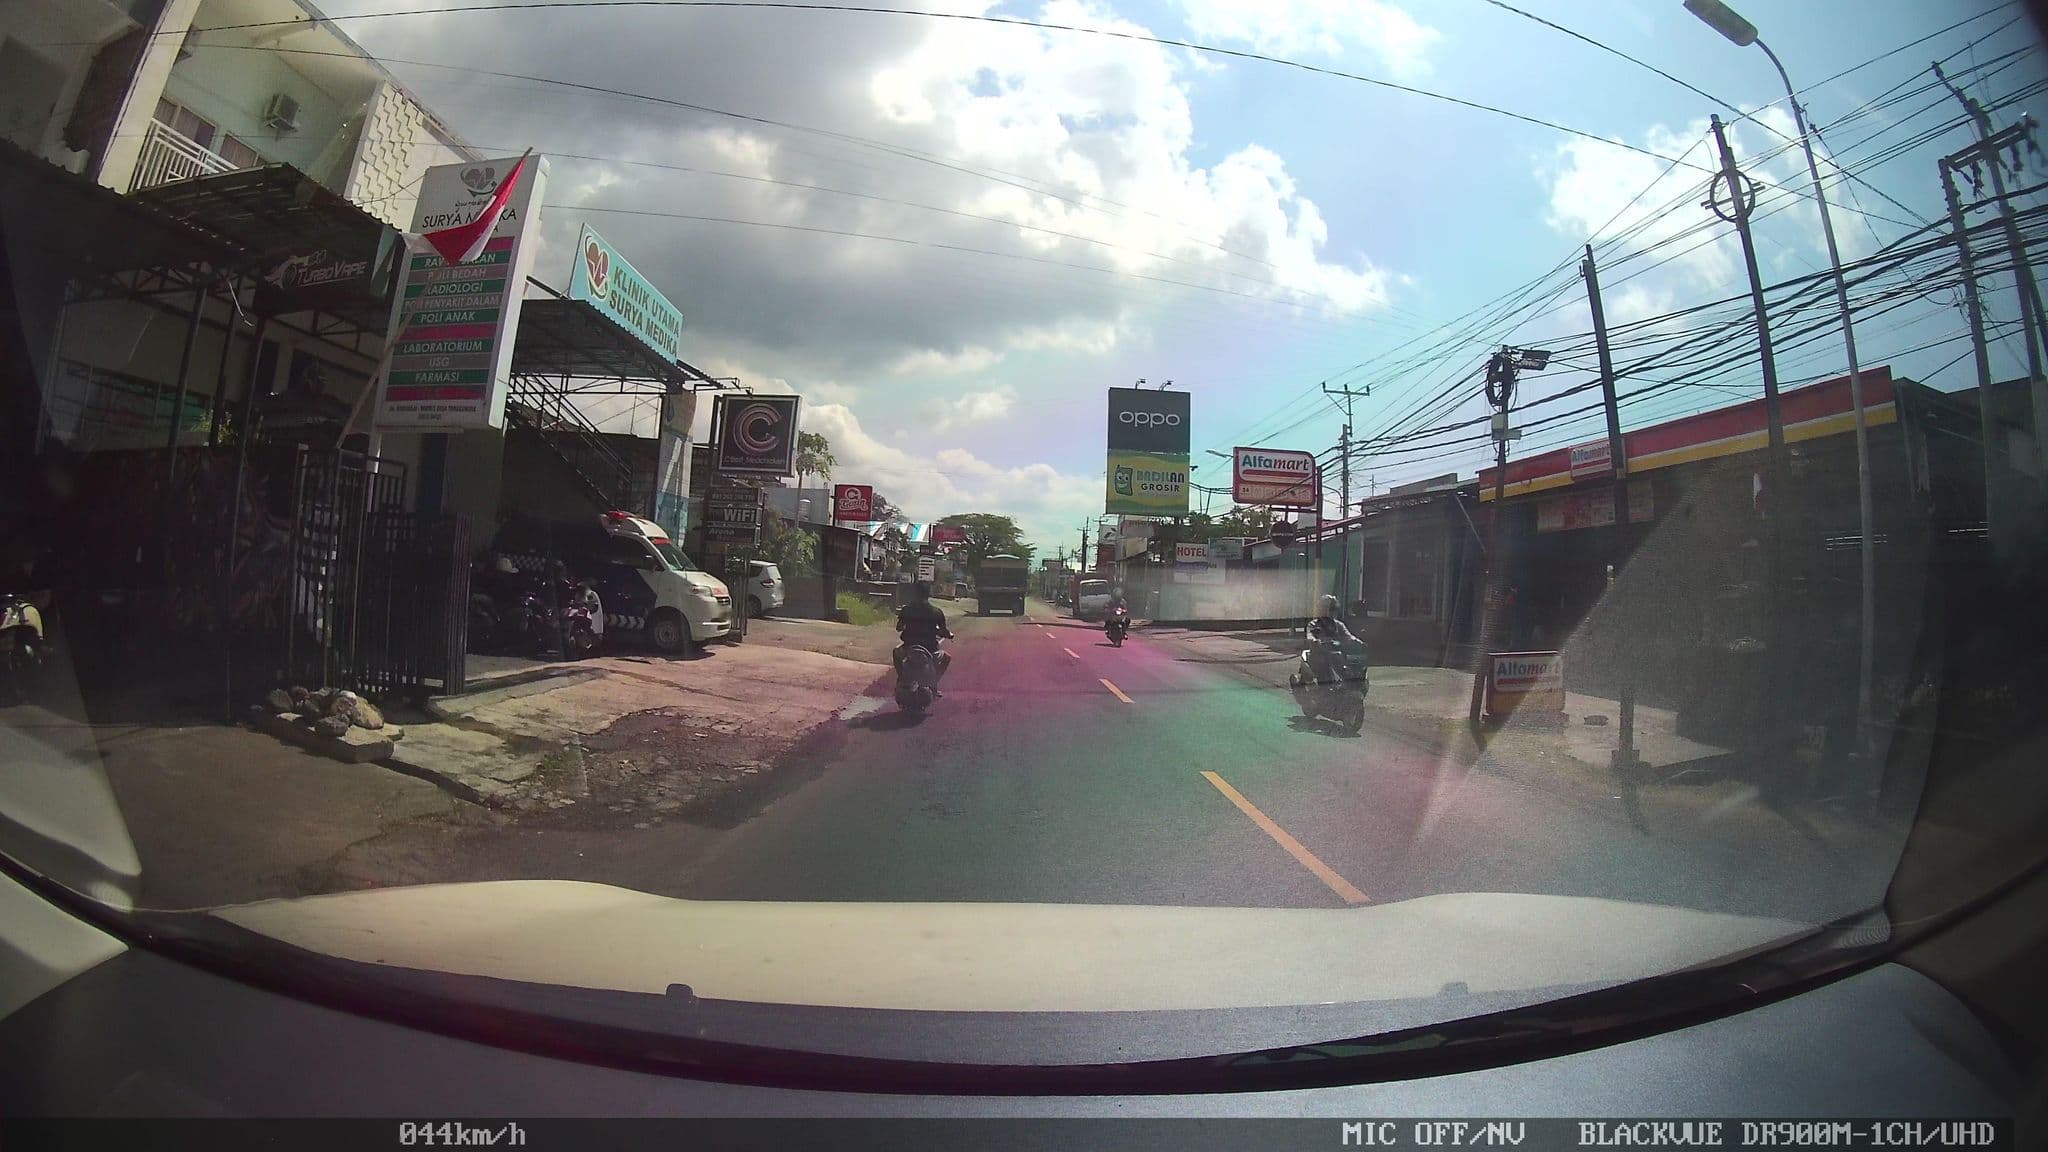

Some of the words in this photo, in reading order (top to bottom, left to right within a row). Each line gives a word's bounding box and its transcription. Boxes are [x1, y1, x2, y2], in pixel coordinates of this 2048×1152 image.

[422, 212, 462, 229] SURYA
[452, 267, 487, 279] BEDAH
[466, 295, 499, 306] DALAM
[613, 266, 650, 310] KLINIK
[652, 299, 680, 338] UTAMA
[420, 312, 443, 324] POLI
[445, 311, 476, 322] ANAK
[609, 290, 643, 331] SURYA
[645, 318, 678, 358] MEDIKA
[403, 341, 482, 353] LABORATORIUM
[429, 357, 450, 367] USG
[415, 371, 460, 383] FARMASI
[1242, 454, 1310, 471] Alfamart
[1140, 483, 1180, 492] GROSIR
[723, 509, 755, 522] WiFi
[1177, 546, 1207, 557] HOTEL
